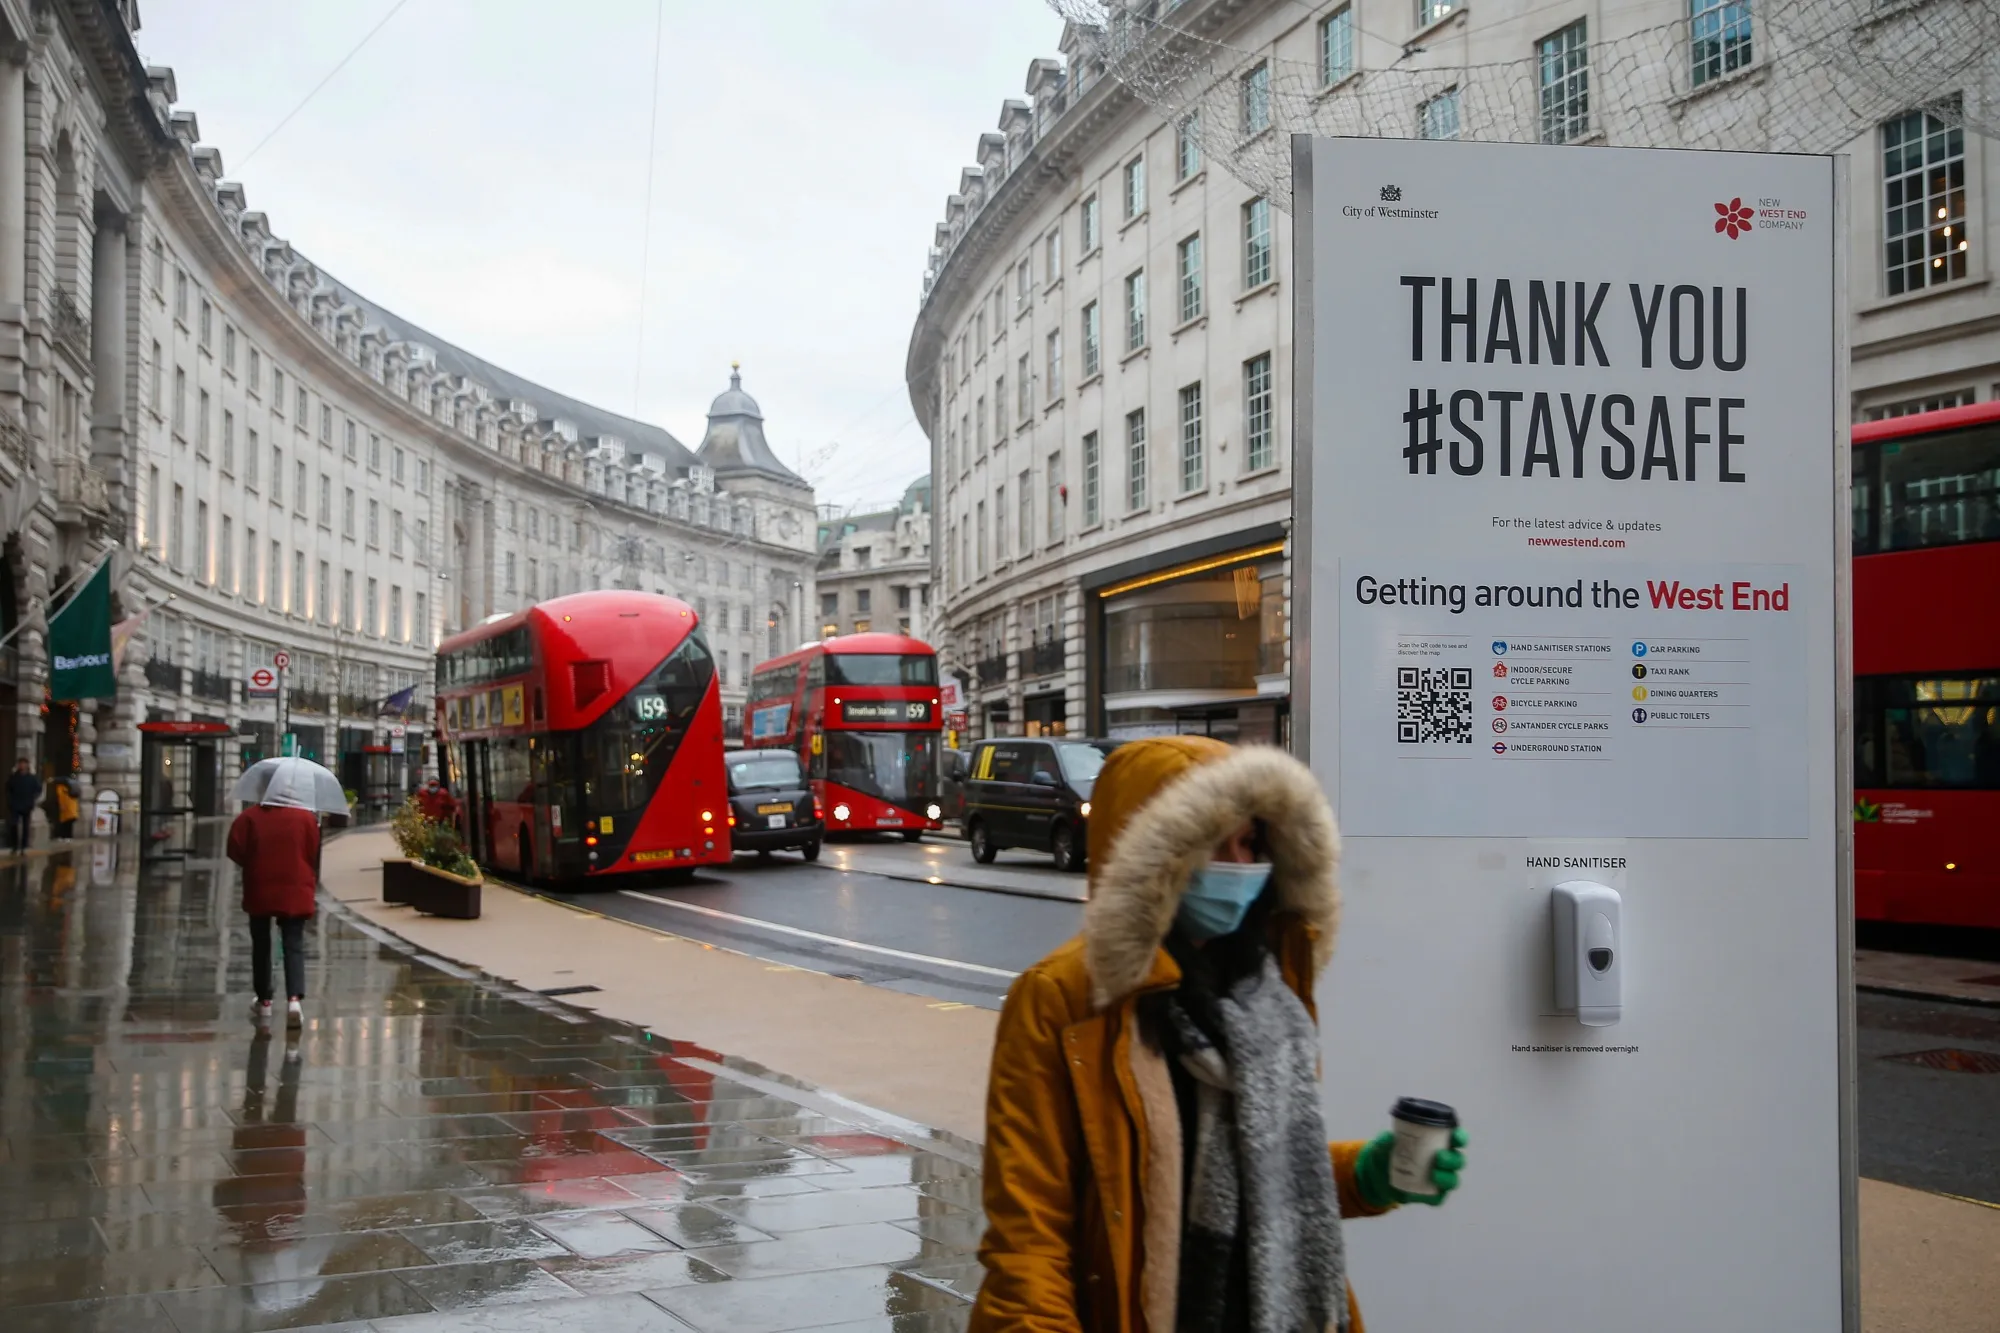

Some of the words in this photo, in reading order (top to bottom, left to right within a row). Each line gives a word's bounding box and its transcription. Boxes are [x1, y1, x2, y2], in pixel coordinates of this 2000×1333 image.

[1758, 198, 1781, 208] NEW
[1342, 206, 1362, 219] City
[1364, 206, 1375, 217] of
[1377, 206, 1439, 219] Westminster
[1759, 209, 1785, 220] WEST
[1786, 210, 1807, 220] END
[1758, 219, 1805, 230] COMPANY
[1400, 275, 1611, 367] THANK
[1629, 283, 1748, 372] YOU
[1402, 388, 1746, 484] #STAYSAFE
[1492, 516, 1511, 529] For
[1512, 517, 1531, 530] the
[1533, 517, 1566, 531] latest
[1567, 518, 1604, 531] advice
[1605, 519, 1615, 531] &
[1617, 519, 1662, 534] updates
[1527, 535, 1626, 549] newwestend.com
[1355, 575, 1467, 614] Getting
[1474, 579, 1584, 609] around
[1590, 580, 1640, 610] the
[1646, 580, 1724, 610] West
[1731, 582, 1789, 612] End
[1533, 644, 1574, 652] SANITISER
[1667, 646, 1701, 654] PARKING
[54, 652, 110, 670] Barbour
[1510, 666, 1573, 674] INDOOR/SECURE
[1668, 668, 1690, 676] RANK
[1678, 690, 1718, 698] QUARTERS
[637, 697, 664, 718] 159
[1510, 699, 1542, 707] BICYCLE
[1544, 700, 1578, 708] PARKING
[906, 703, 925, 718] 159
[1650, 712, 1678, 720] PUBLIC
[1680, 712, 1710, 720] TOILETS
[1510, 722, 1557, 730] SANTANDER
[1558, 722, 1582, 730] CYCLE
[1510, 744, 1569, 752] UNDERGROUND
[1526, 856, 1561, 868] HAND
[1563, 857, 1627, 869] SANITISER
[1511, 1045, 1531, 1053] Hand
[1531, 1045, 1564, 1053] sanitiser
[1564, 1045, 1571, 1053] is
[1572, 1045, 1604, 1053] removed
[1605, 1045, 1639, 1054] overnight
